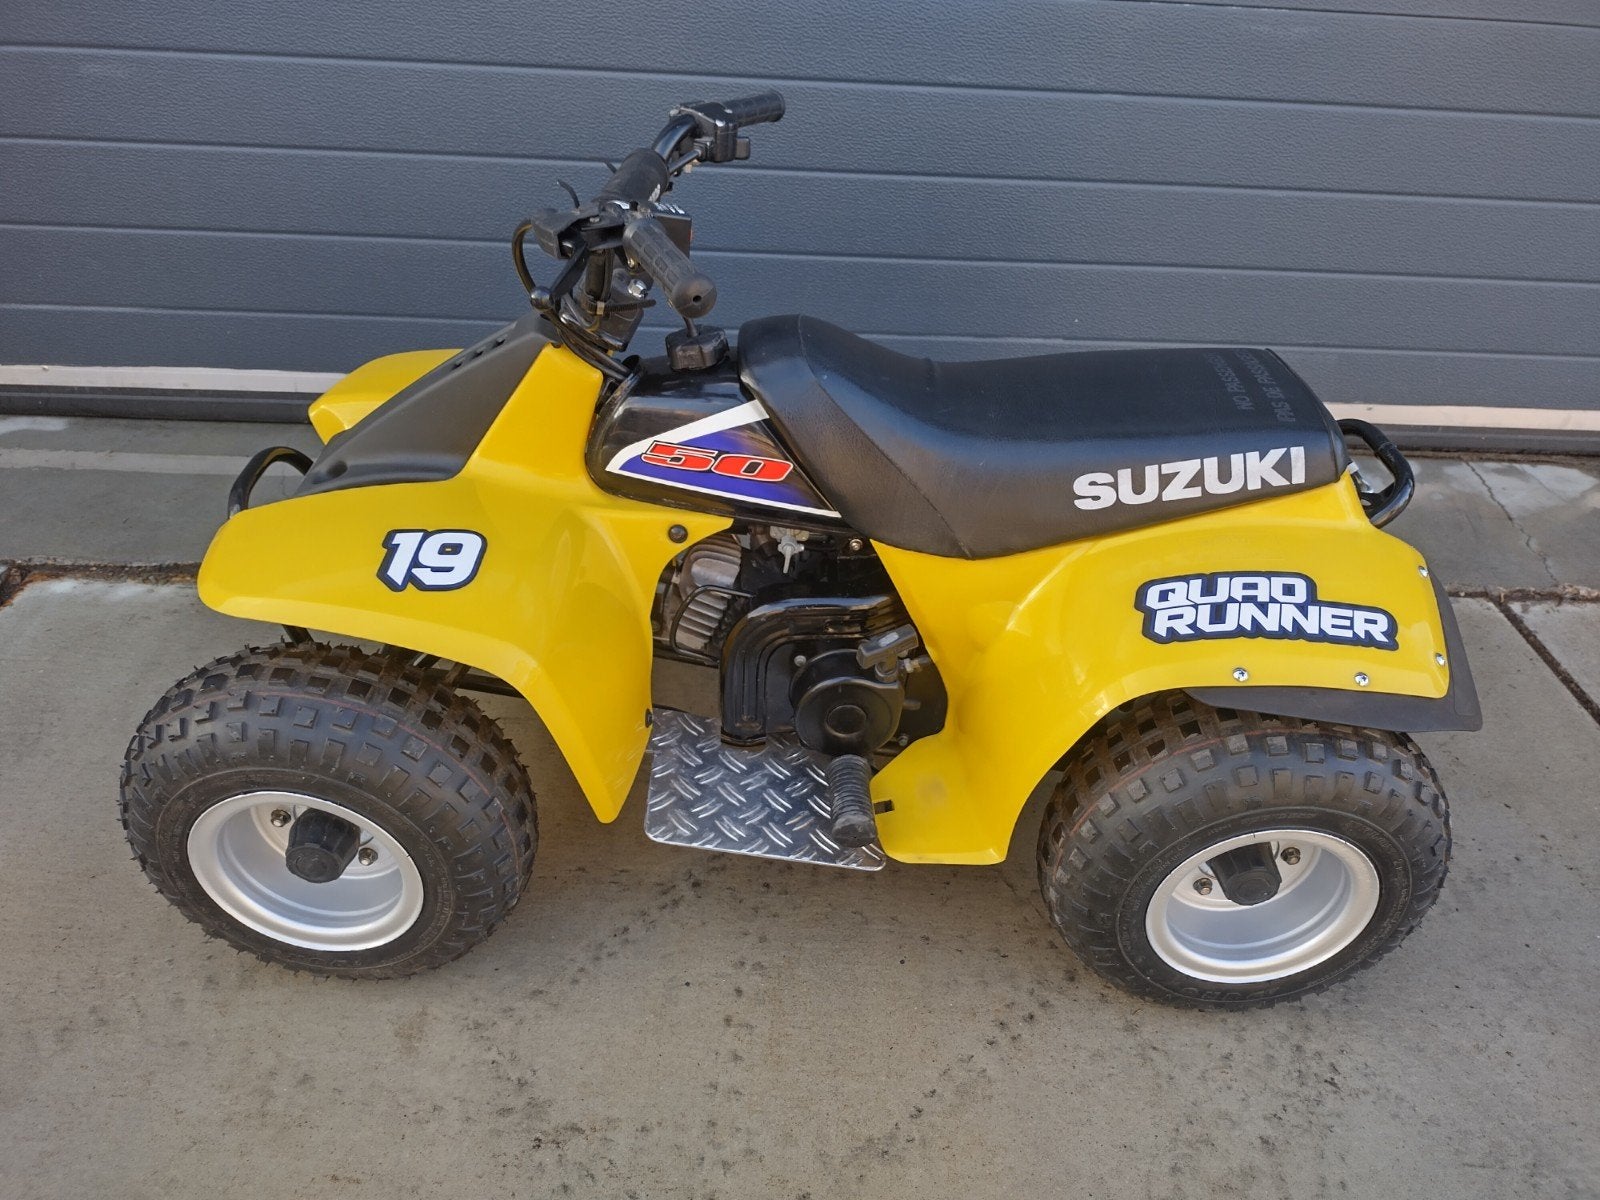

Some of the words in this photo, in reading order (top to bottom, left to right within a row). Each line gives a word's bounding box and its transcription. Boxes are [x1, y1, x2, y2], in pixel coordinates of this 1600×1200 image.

[1232, 395, 1256, 411] NO
[641, 440, 794, 482] 50
[1073, 446, 1306, 511] SUZUKI
[383, 530, 486, 589] 19
[1144, 575, 1308, 610] QUAD
[1153, 602, 1390, 643] RUNNER
